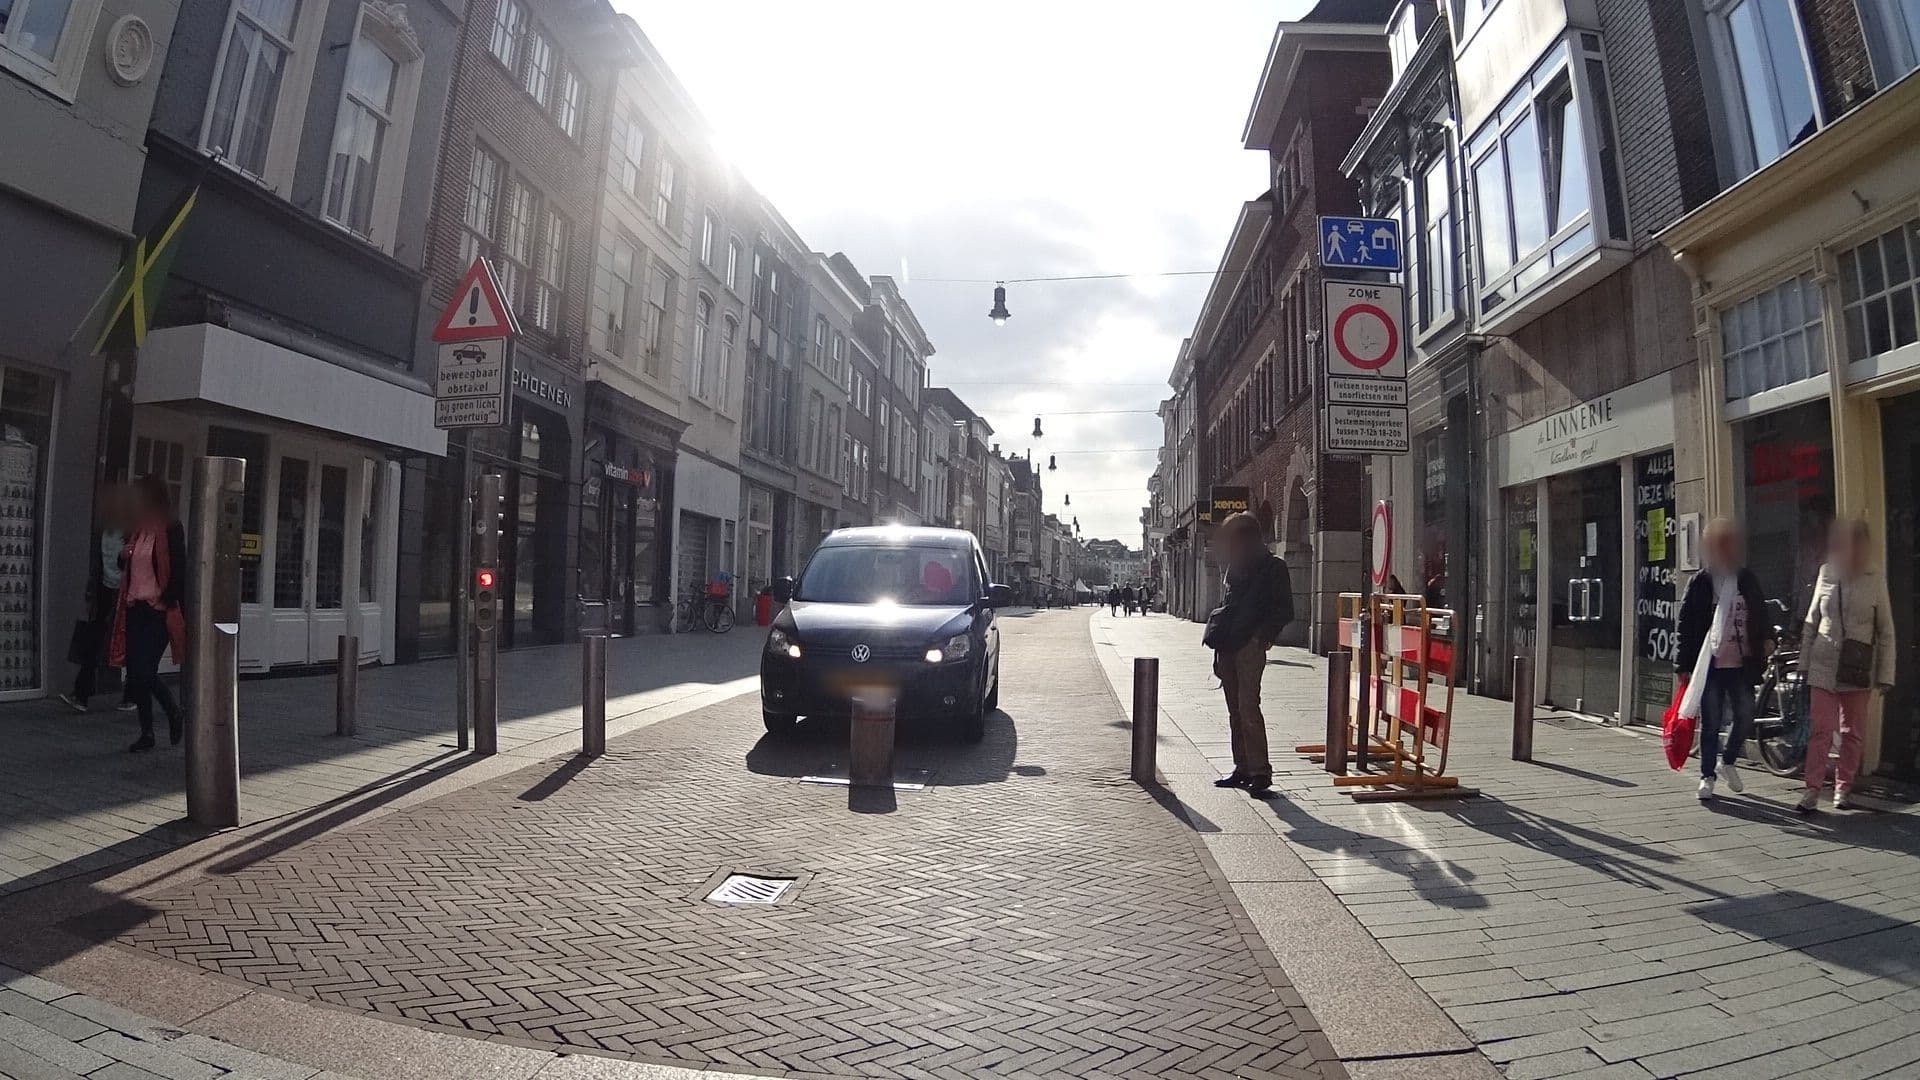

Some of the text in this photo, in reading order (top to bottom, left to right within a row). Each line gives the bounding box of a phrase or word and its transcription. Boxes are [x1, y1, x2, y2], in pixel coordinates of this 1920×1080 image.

[1348, 288, 1381, 299] ZONE
[440, 368, 498, 381] beweegbaar
[447, 381, 488, 394] obstakel
[1333, 381, 1403, 392] fietsen toegestaan
[1338, 391, 1382, 400] snorfietsen
[440, 400, 496, 413] bij groen licht
[454, 412, 489, 423] voertuig
[1347, 408, 1391, 418] uitgezonderd
[1334, 417, 1403, 428] bestemmingsverkeer
[1546, 397, 1612, 442] LINNERIE
[1336, 427, 1359, 435] tussen
[1214, 500, 1248, 510] xenos
